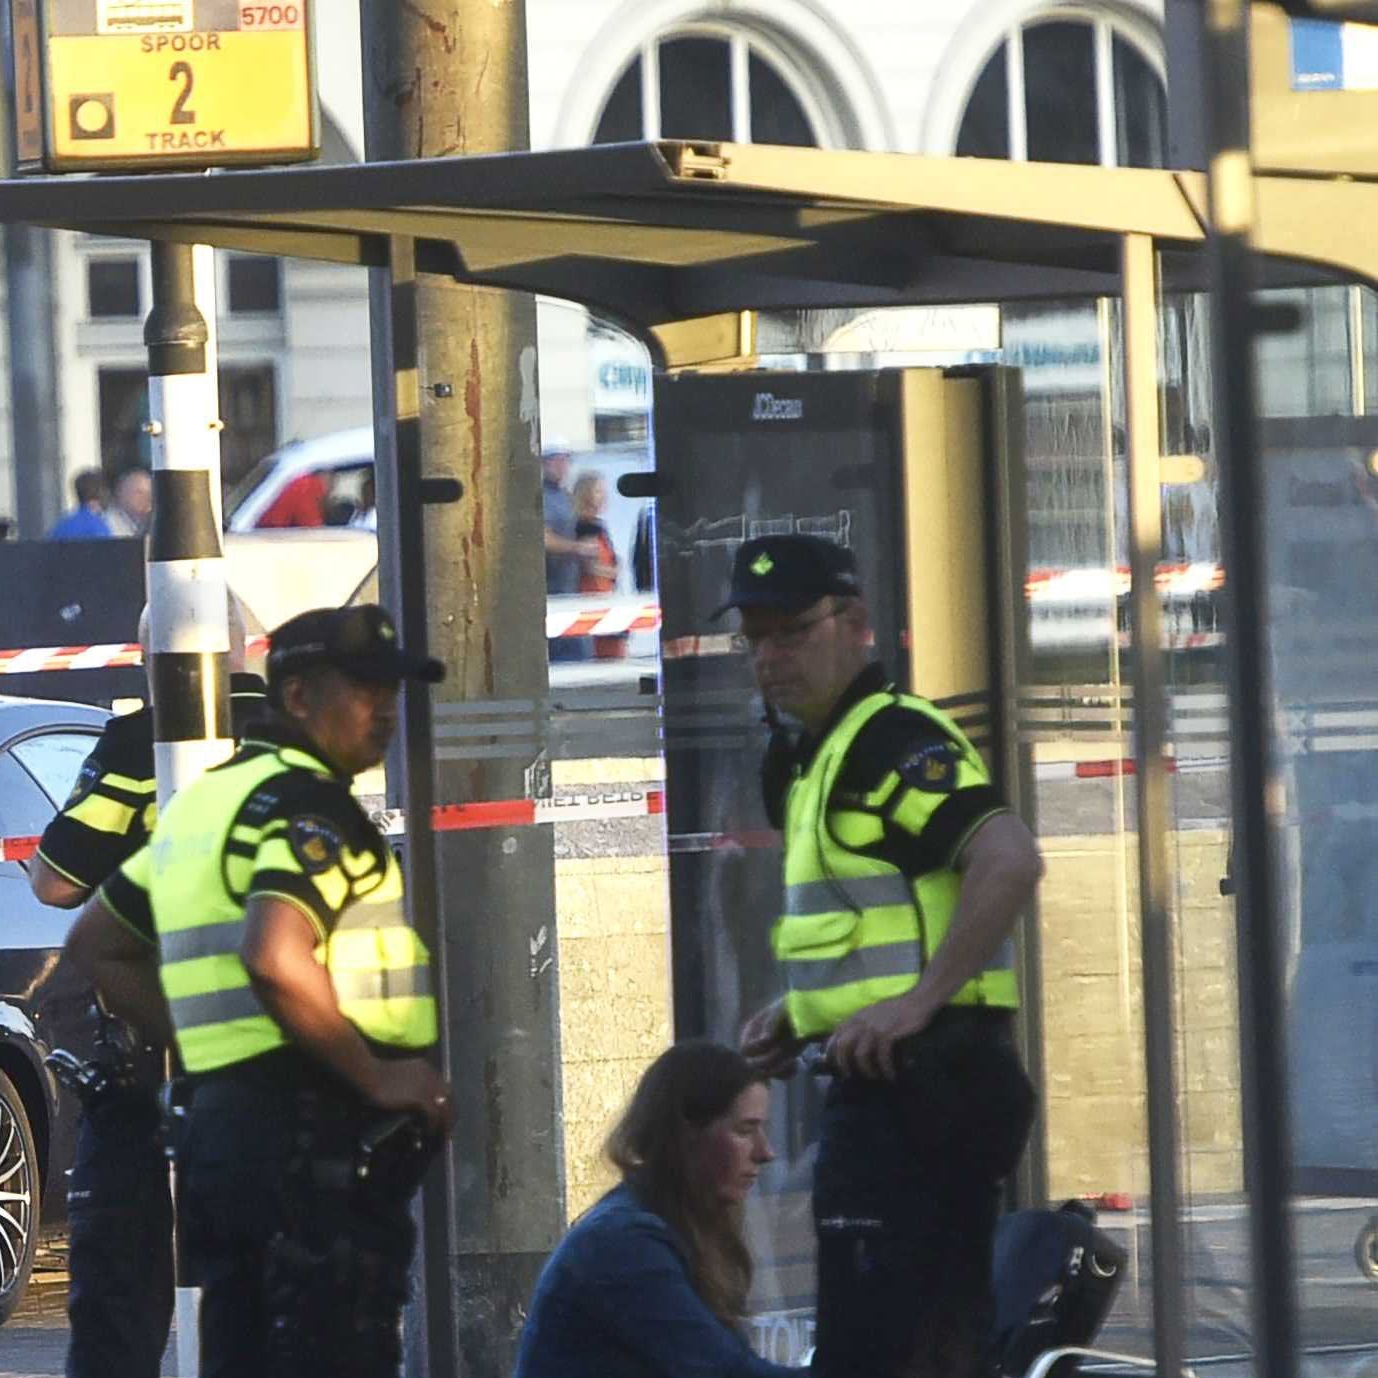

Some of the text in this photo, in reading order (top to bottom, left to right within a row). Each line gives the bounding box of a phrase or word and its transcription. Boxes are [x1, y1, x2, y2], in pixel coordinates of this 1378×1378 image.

[242, 6, 298, 25] 5700
[141, 33, 221, 53] SPOOR
[169, 60, 196, 125] 2
[145, 130, 226, 150] TRACK
